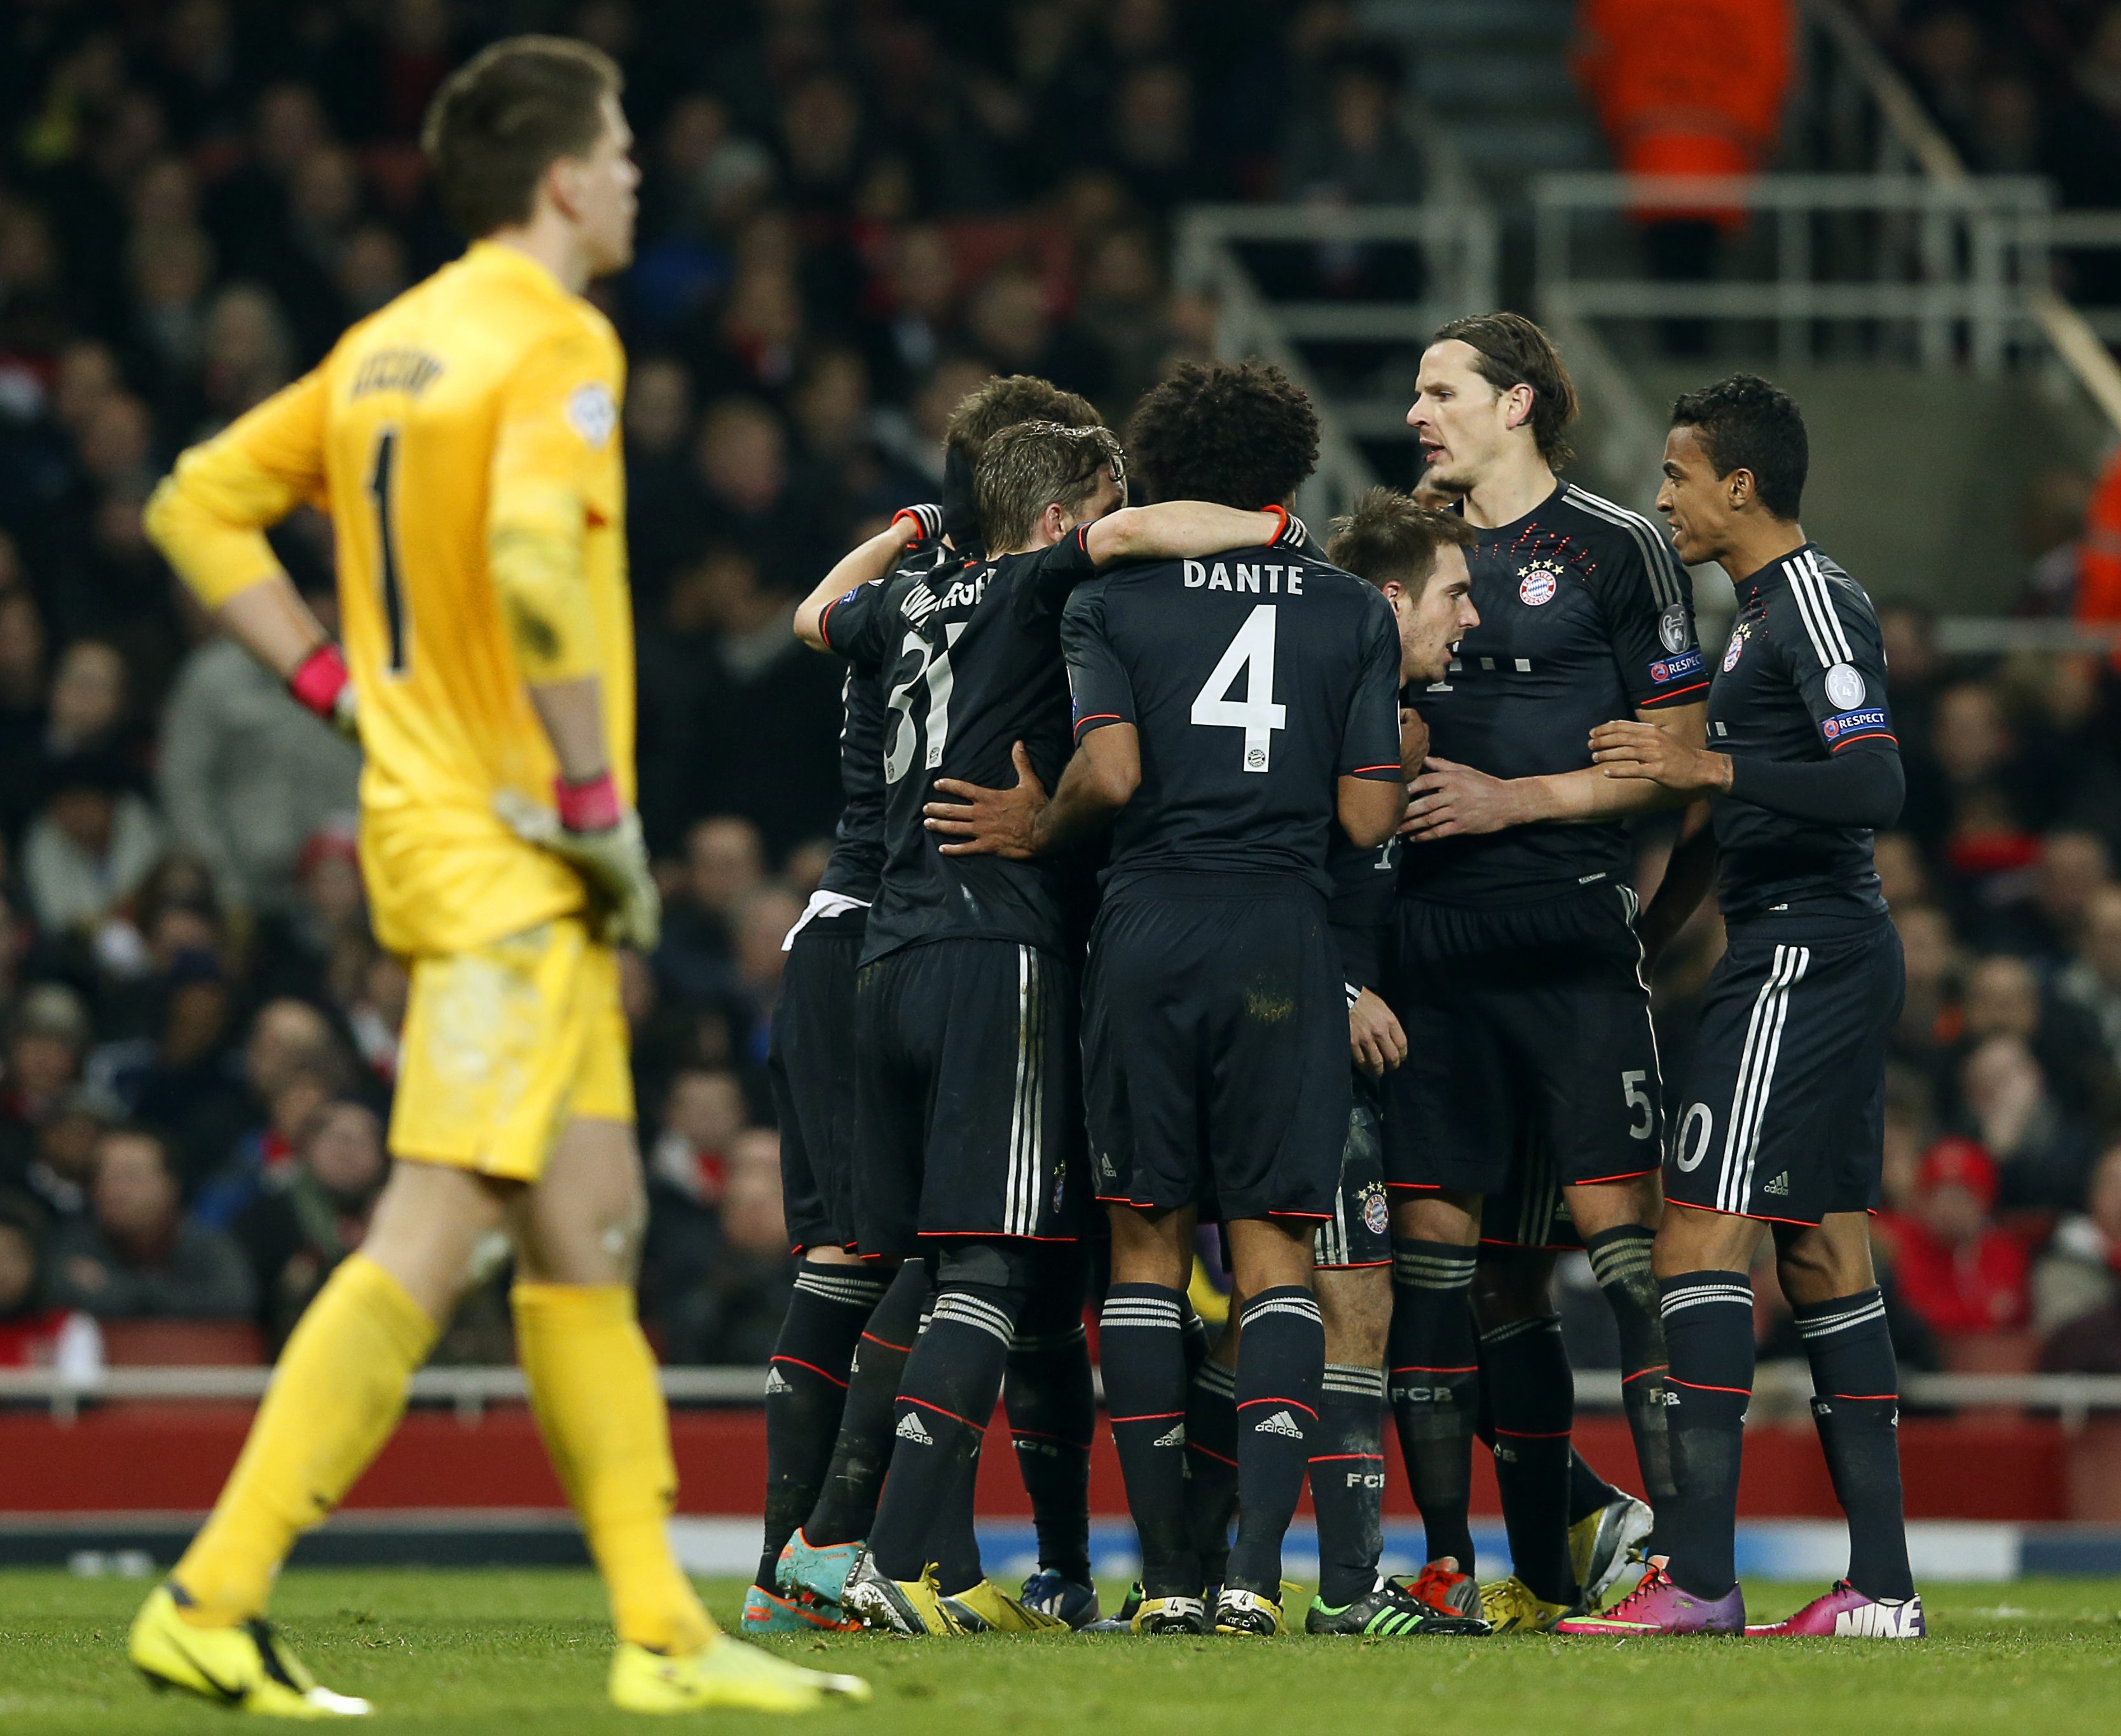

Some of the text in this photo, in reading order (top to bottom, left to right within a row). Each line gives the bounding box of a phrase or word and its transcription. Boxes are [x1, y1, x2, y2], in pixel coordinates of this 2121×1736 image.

[370, 431, 408, 674] 1
[1183, 560, 1303, 595] DANTE
[1668, 654, 1702, 674] RESPEC
[884, 622, 968, 784] 31
[1190, 604, 1286, 773] 4
[1838, 713, 1884, 729] RESPECT
[1621, 1070, 1653, 1140] 5
[1671, 1101, 1713, 1173] 0
[1392, 1387, 1453, 1402] FCB
[1255, 1424, 1303, 1440] adidas
[1170, 1599, 1179, 1613] 4
[1835, 1589, 1921, 1638] NIKE
